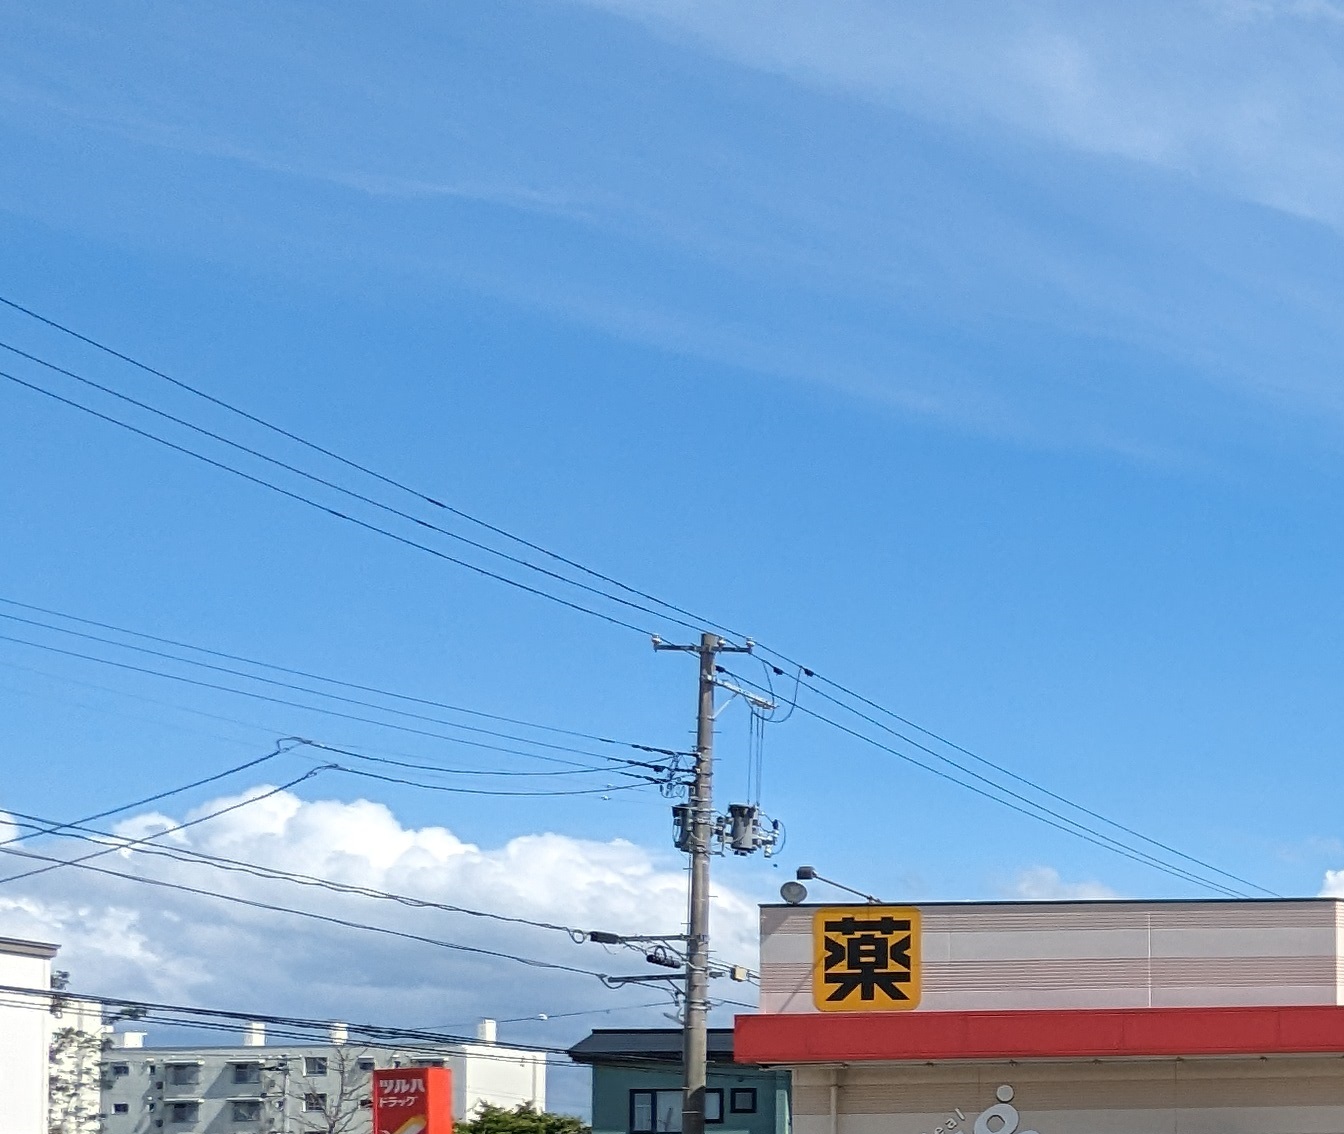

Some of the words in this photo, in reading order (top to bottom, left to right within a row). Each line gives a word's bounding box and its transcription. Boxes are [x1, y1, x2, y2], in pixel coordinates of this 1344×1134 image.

[824, 917, 911, 1001] 薬
[380, 1079, 426, 1093] ツルハ
[380, 1096, 419, 1107] ドラッグ
